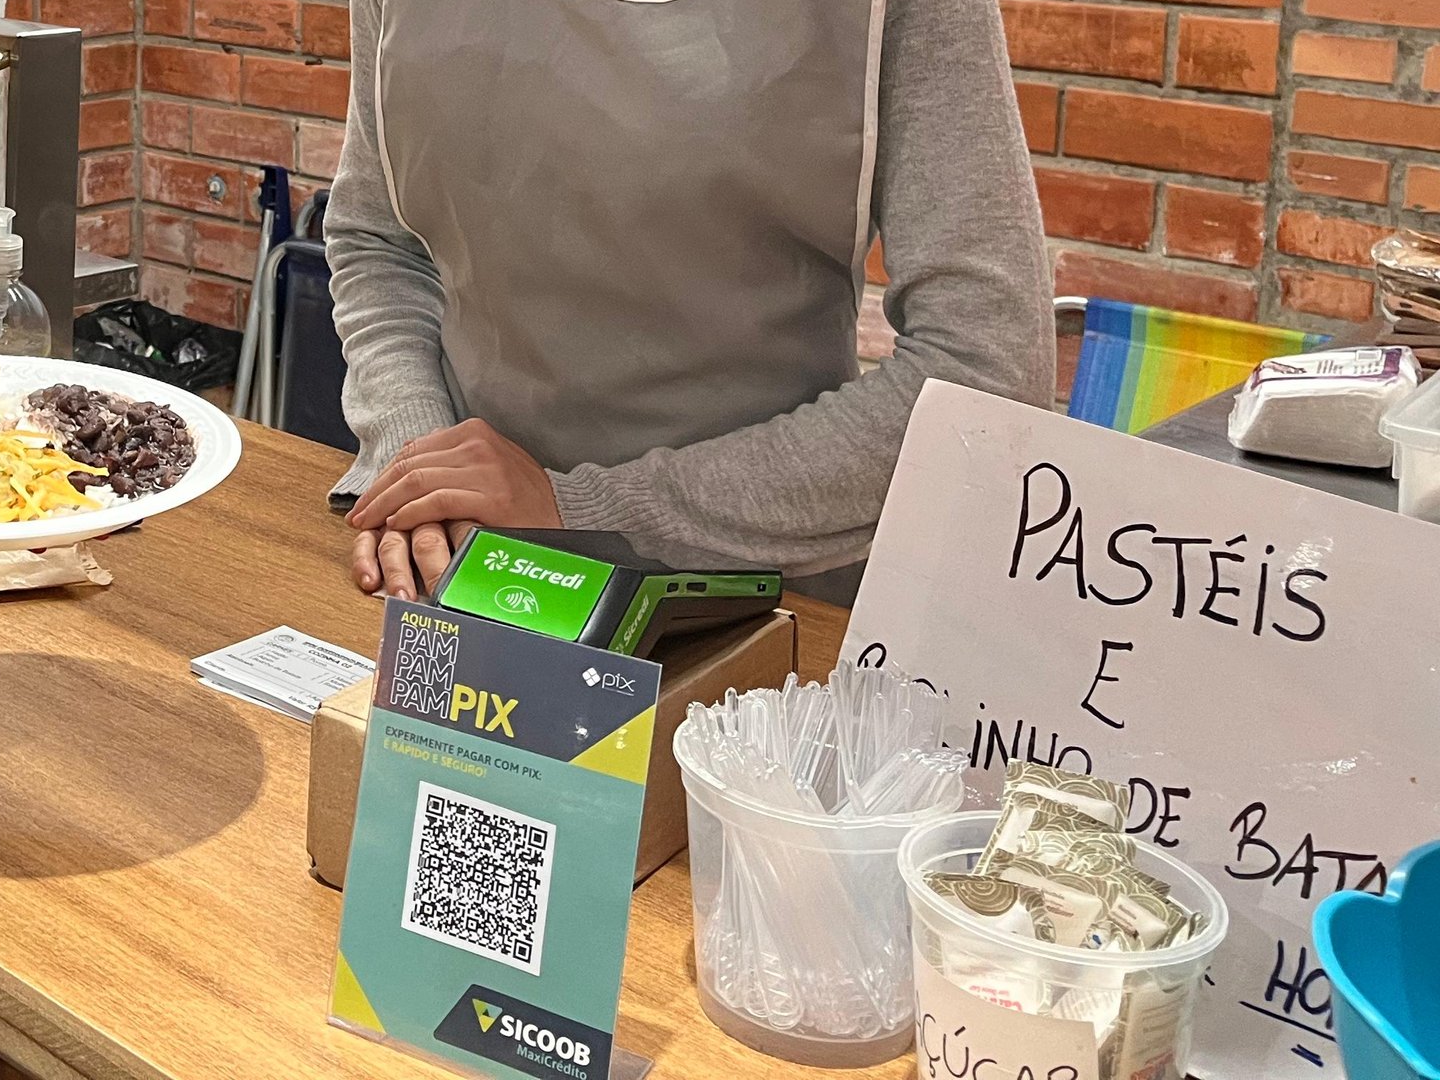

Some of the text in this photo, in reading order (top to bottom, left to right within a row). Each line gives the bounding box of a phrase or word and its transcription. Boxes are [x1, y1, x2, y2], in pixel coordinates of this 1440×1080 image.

[508, 558, 587, 590] Sicredi
[1008, 462, 1328, 642] PASTÉIS
[399, 623, 459, 664] PAM
[401, 611, 459, 636] AQUI TEM
[394, 649, 455, 691] PAM
[602, 673, 636, 693] pix
[1080, 640, 1134, 729] E
[390, 677, 519, 738] PAM PIX
[385, 725, 543, 781] EXPERIMENTE PAGAR COM PIX:
[1124, 777, 1191, 848] DE
[500, 1014, 591, 1066] SICOOB
[516, 1043, 588, 1080] MaxiCrédito
